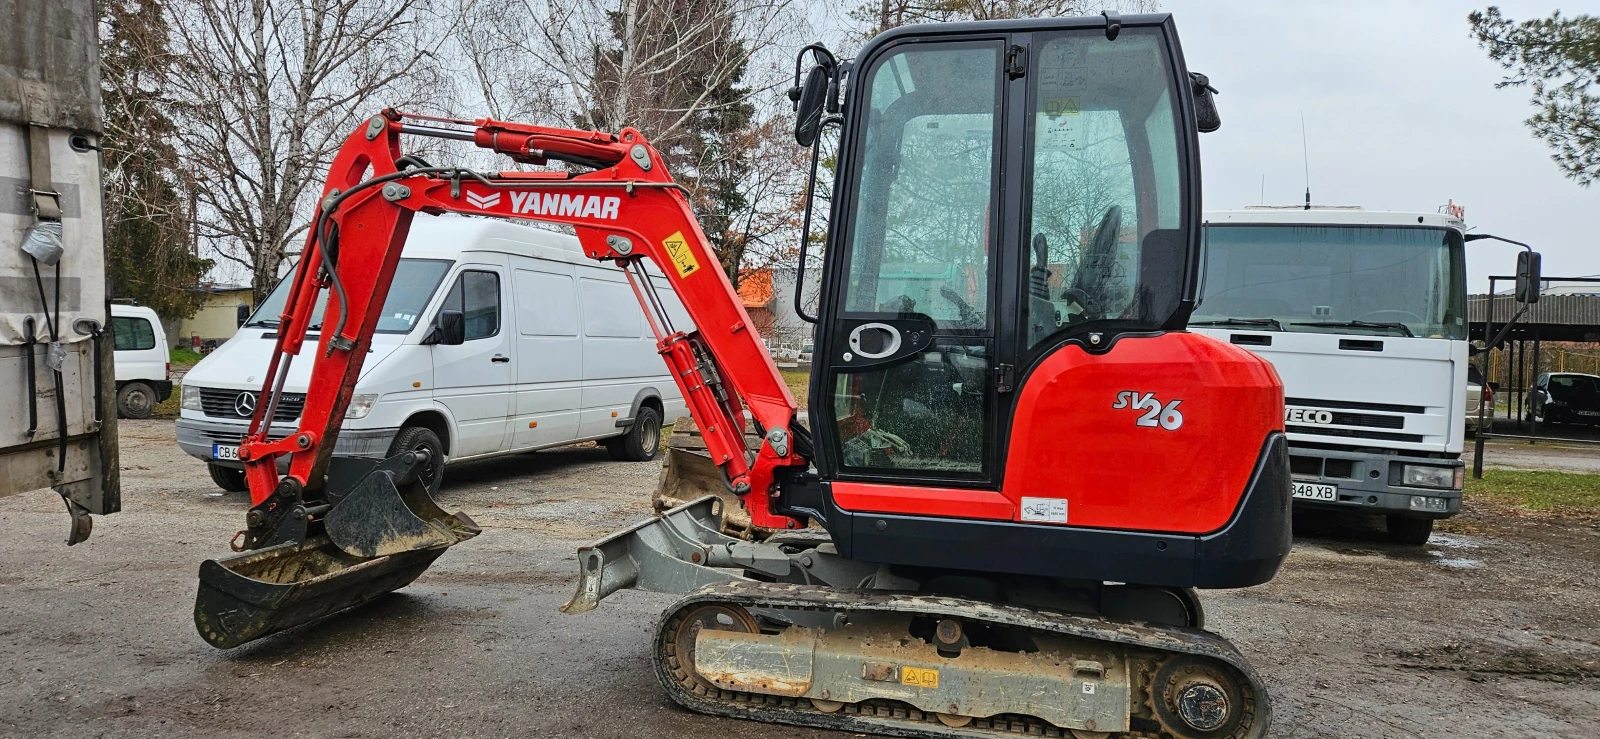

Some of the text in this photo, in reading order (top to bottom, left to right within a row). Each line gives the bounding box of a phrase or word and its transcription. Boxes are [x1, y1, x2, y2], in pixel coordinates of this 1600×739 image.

[509, 191, 620, 219] YANMAR
[219, 446, 231, 458] CB
[1316, 486, 1333, 499] XB
